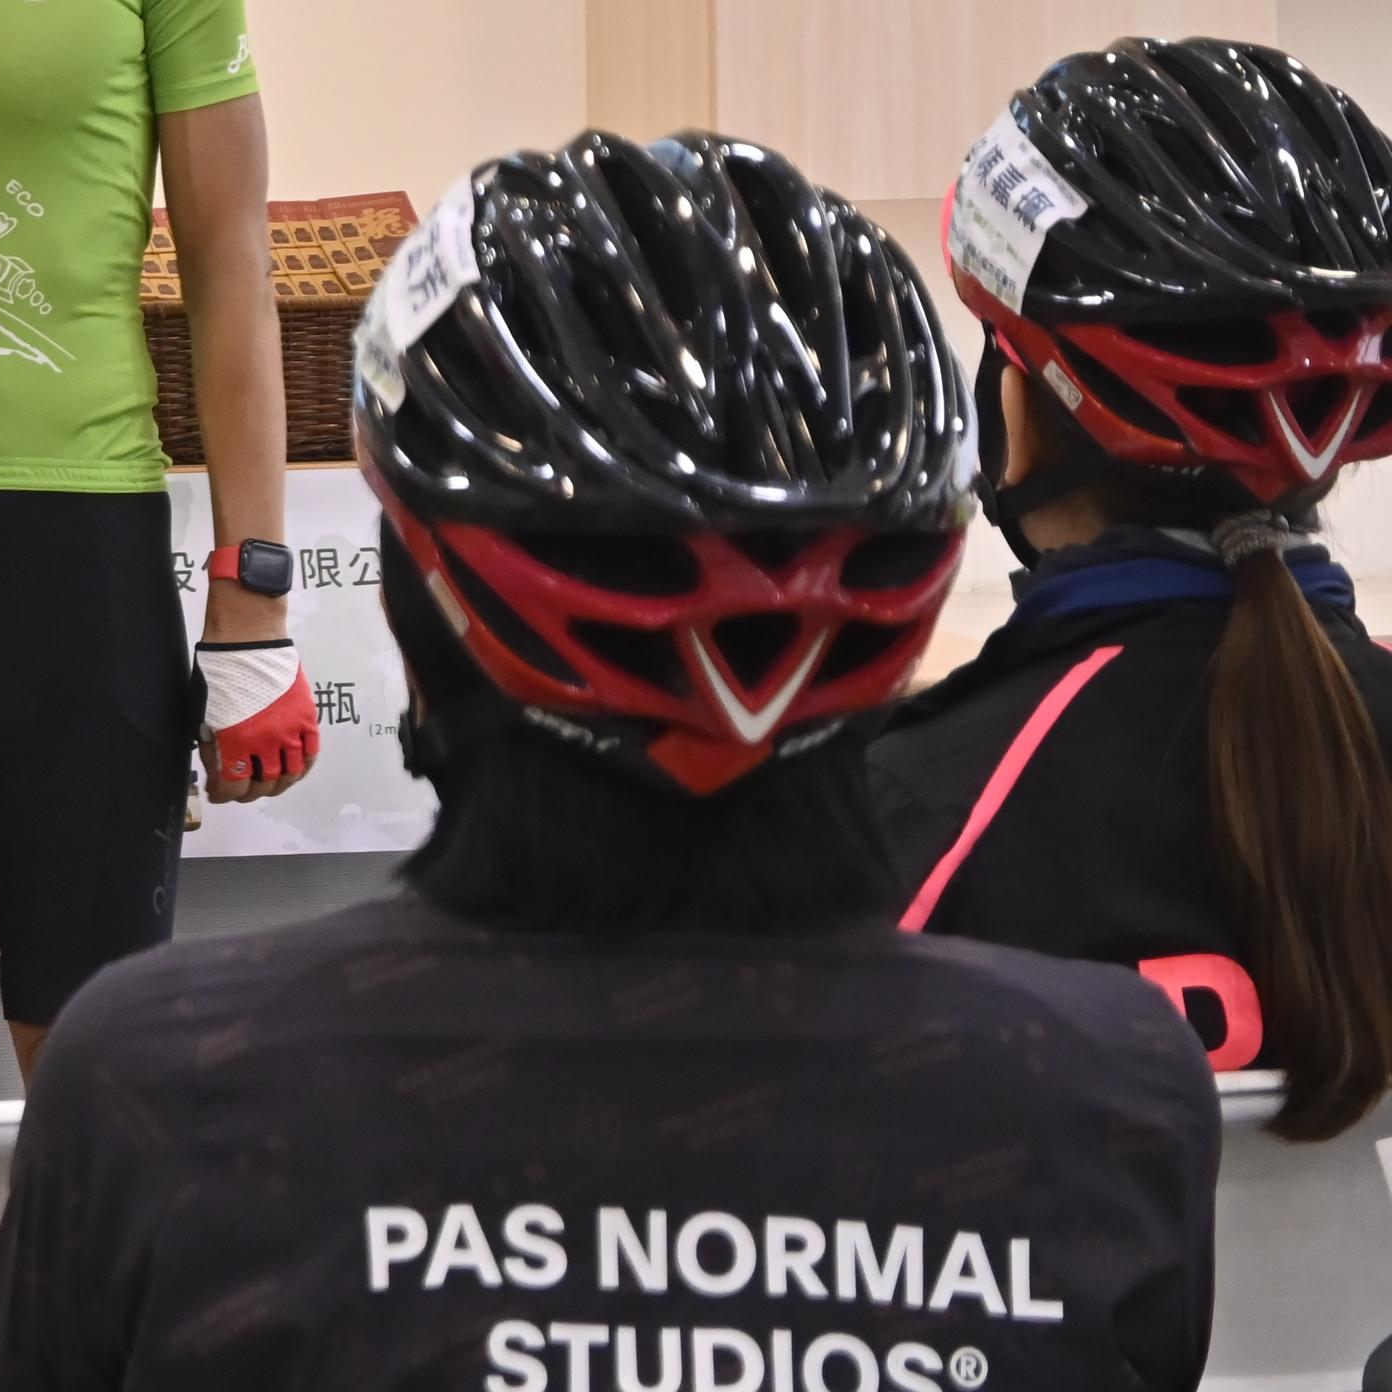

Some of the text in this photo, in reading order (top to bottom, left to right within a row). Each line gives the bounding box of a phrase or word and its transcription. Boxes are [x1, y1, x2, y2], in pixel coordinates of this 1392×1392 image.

[6, 179, 45, 217] ECO
[363, 1202, 1066, 1322] PAS NORMAL
